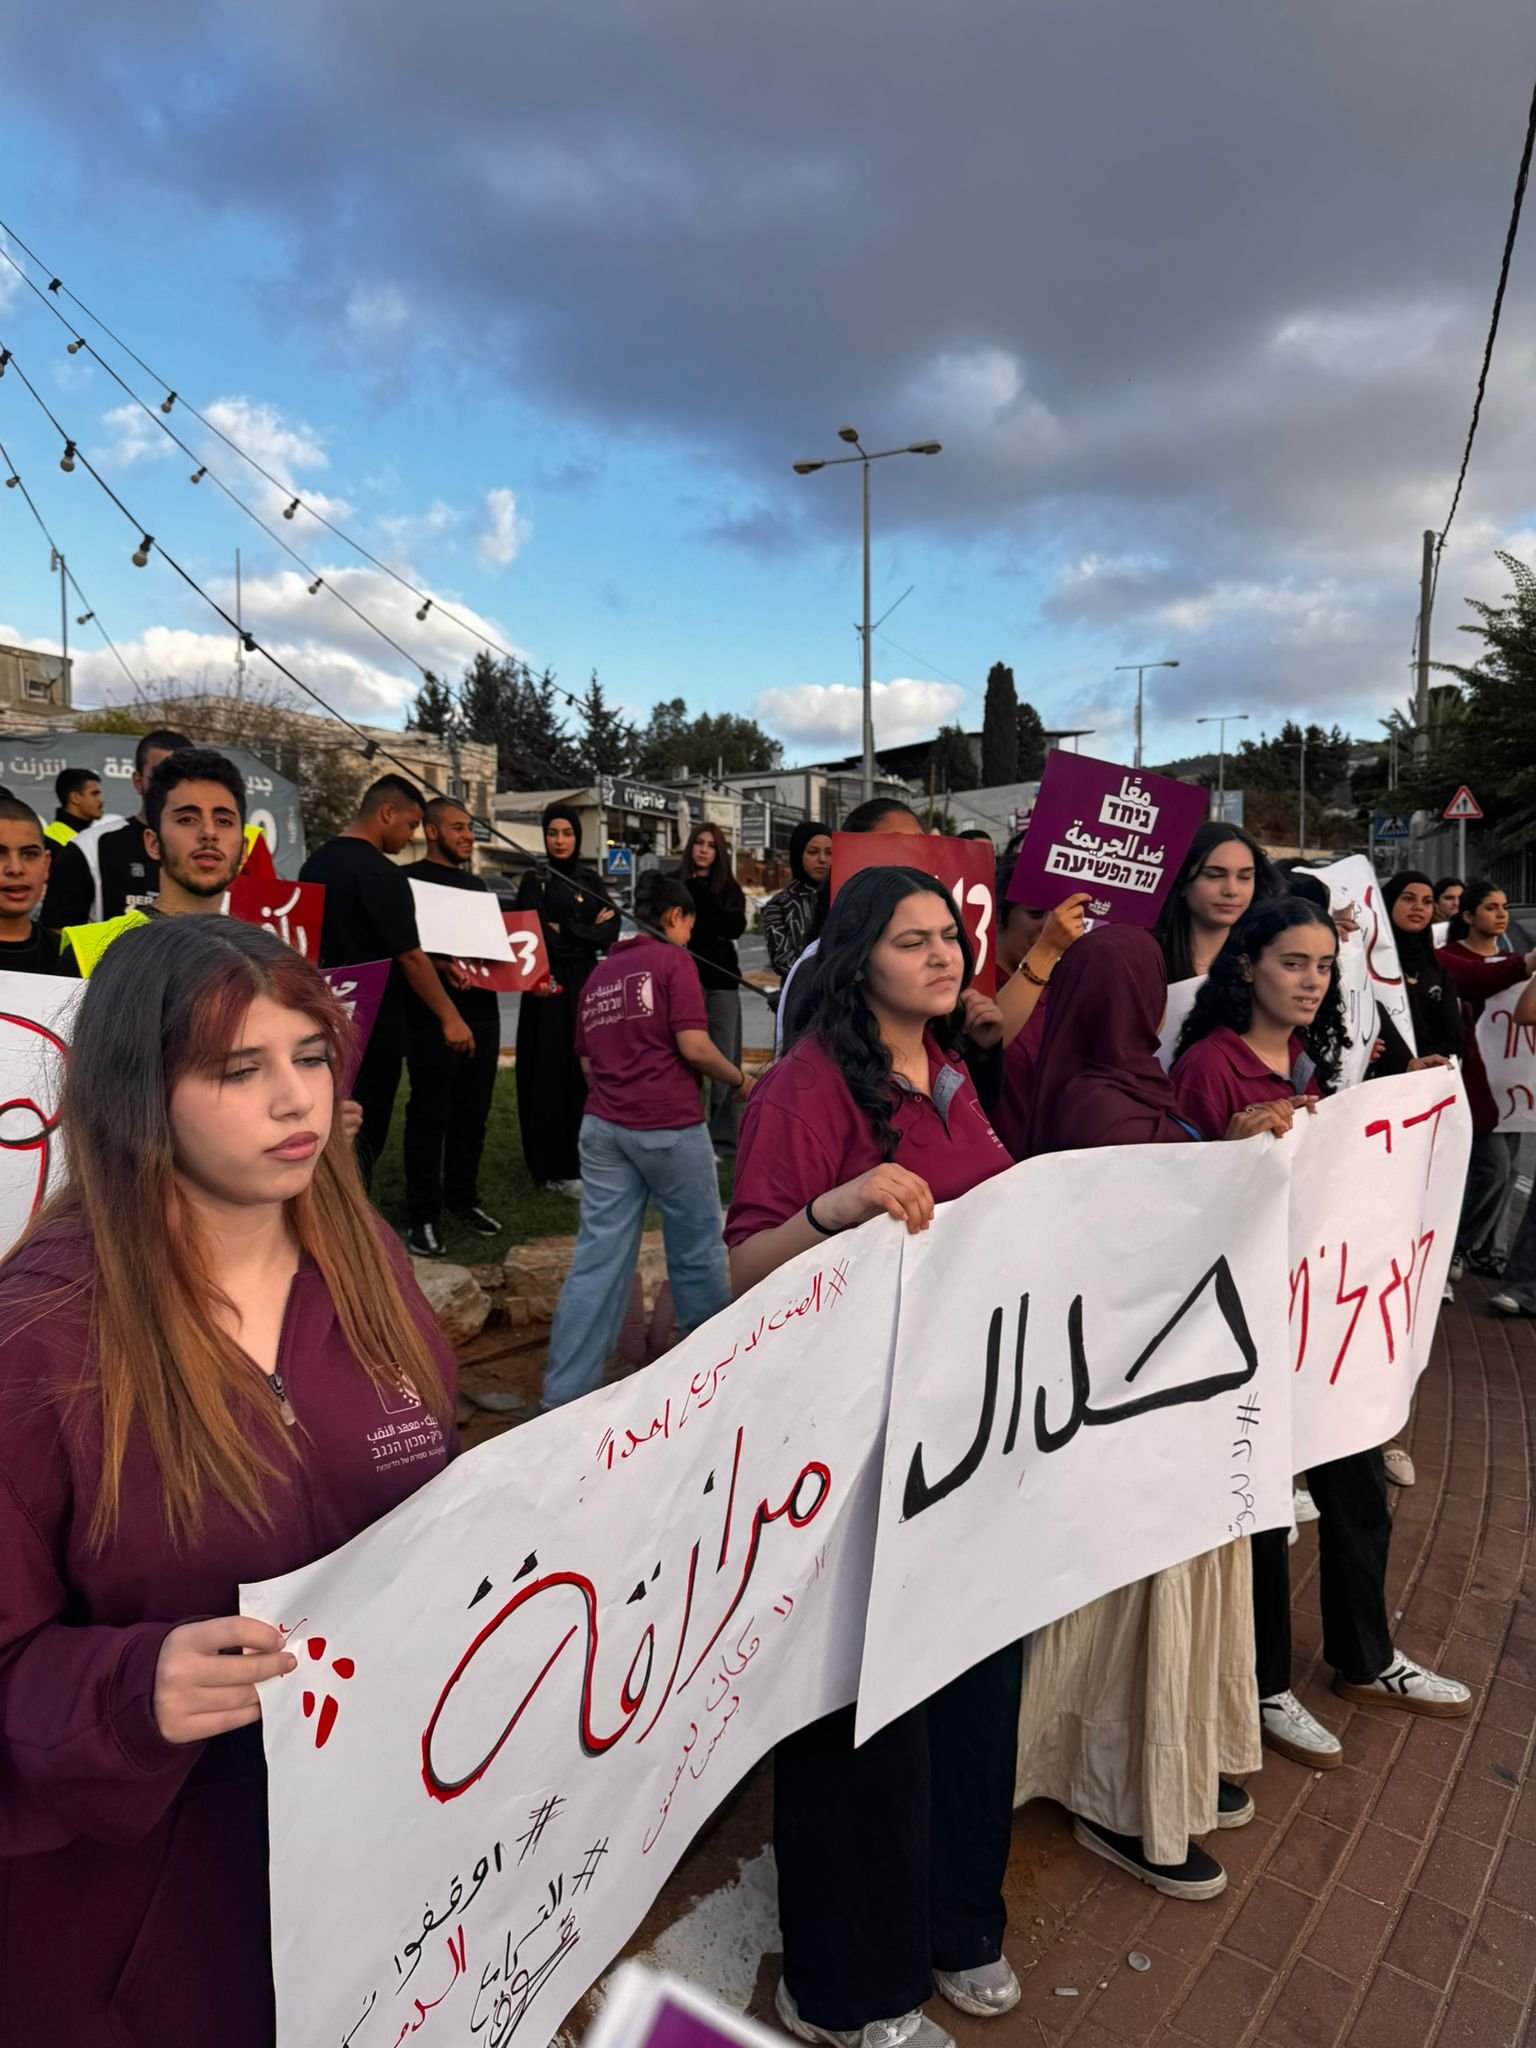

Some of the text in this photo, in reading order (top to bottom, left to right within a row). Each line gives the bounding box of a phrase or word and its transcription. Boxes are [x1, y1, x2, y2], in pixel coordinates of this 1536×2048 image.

[1108, 801, 1151, 829] ביחד
[1064, 819, 1165, 865] ضد الجريمة
[1053, 851, 1158, 889] נגד הפשיעה
[371, 1441, 403, 1460] הנגב
